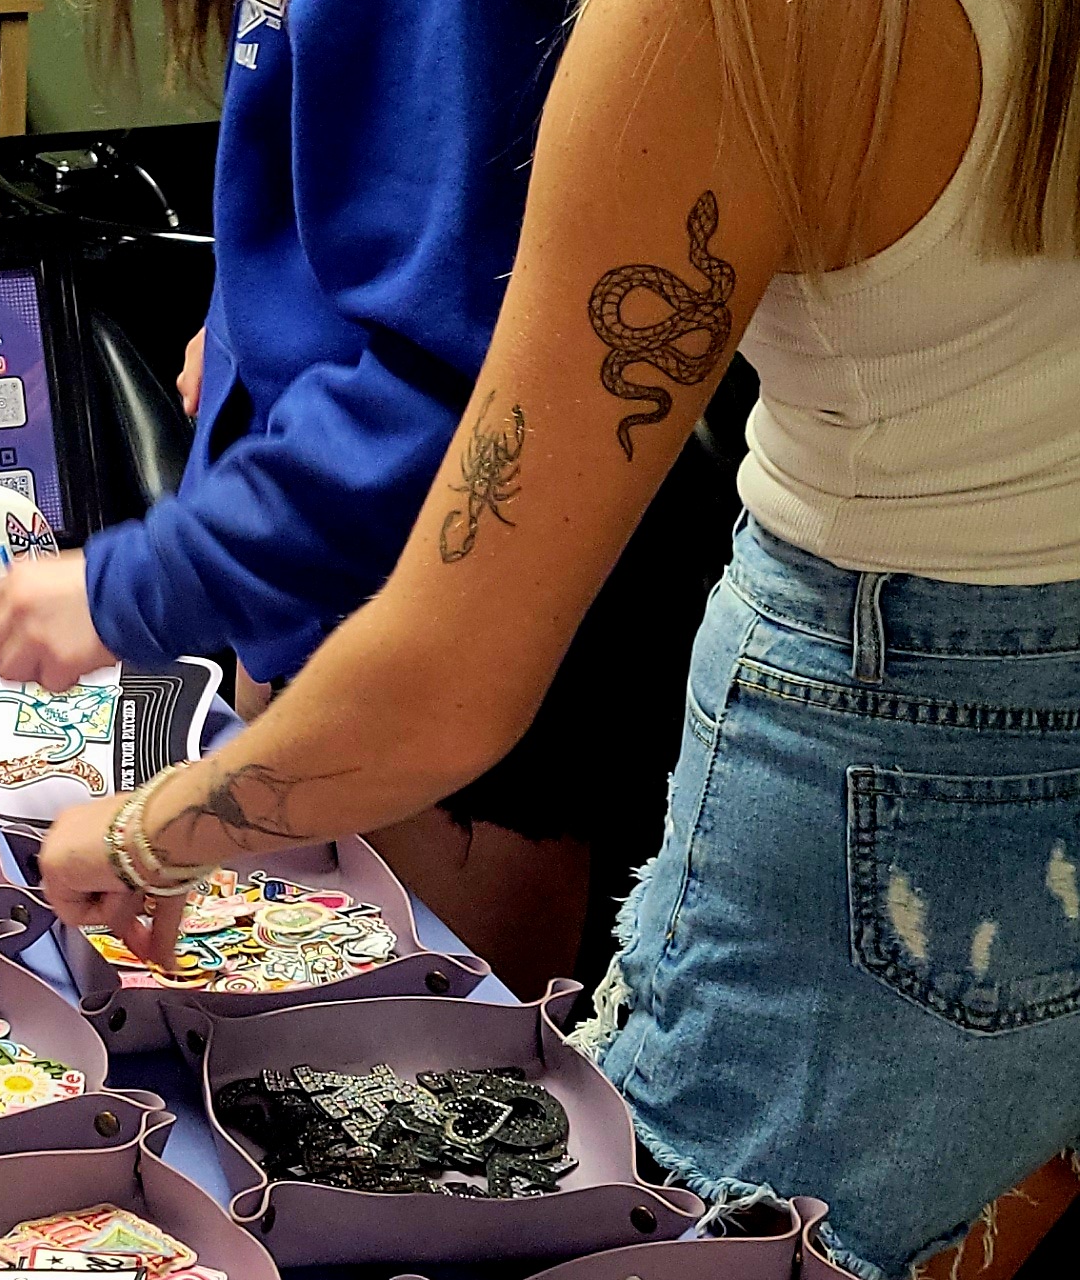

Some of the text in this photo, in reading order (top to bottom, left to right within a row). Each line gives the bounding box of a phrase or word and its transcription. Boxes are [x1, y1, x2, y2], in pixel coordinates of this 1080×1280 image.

[121, 700, 135, 791] PICK YOUR PATCHES
